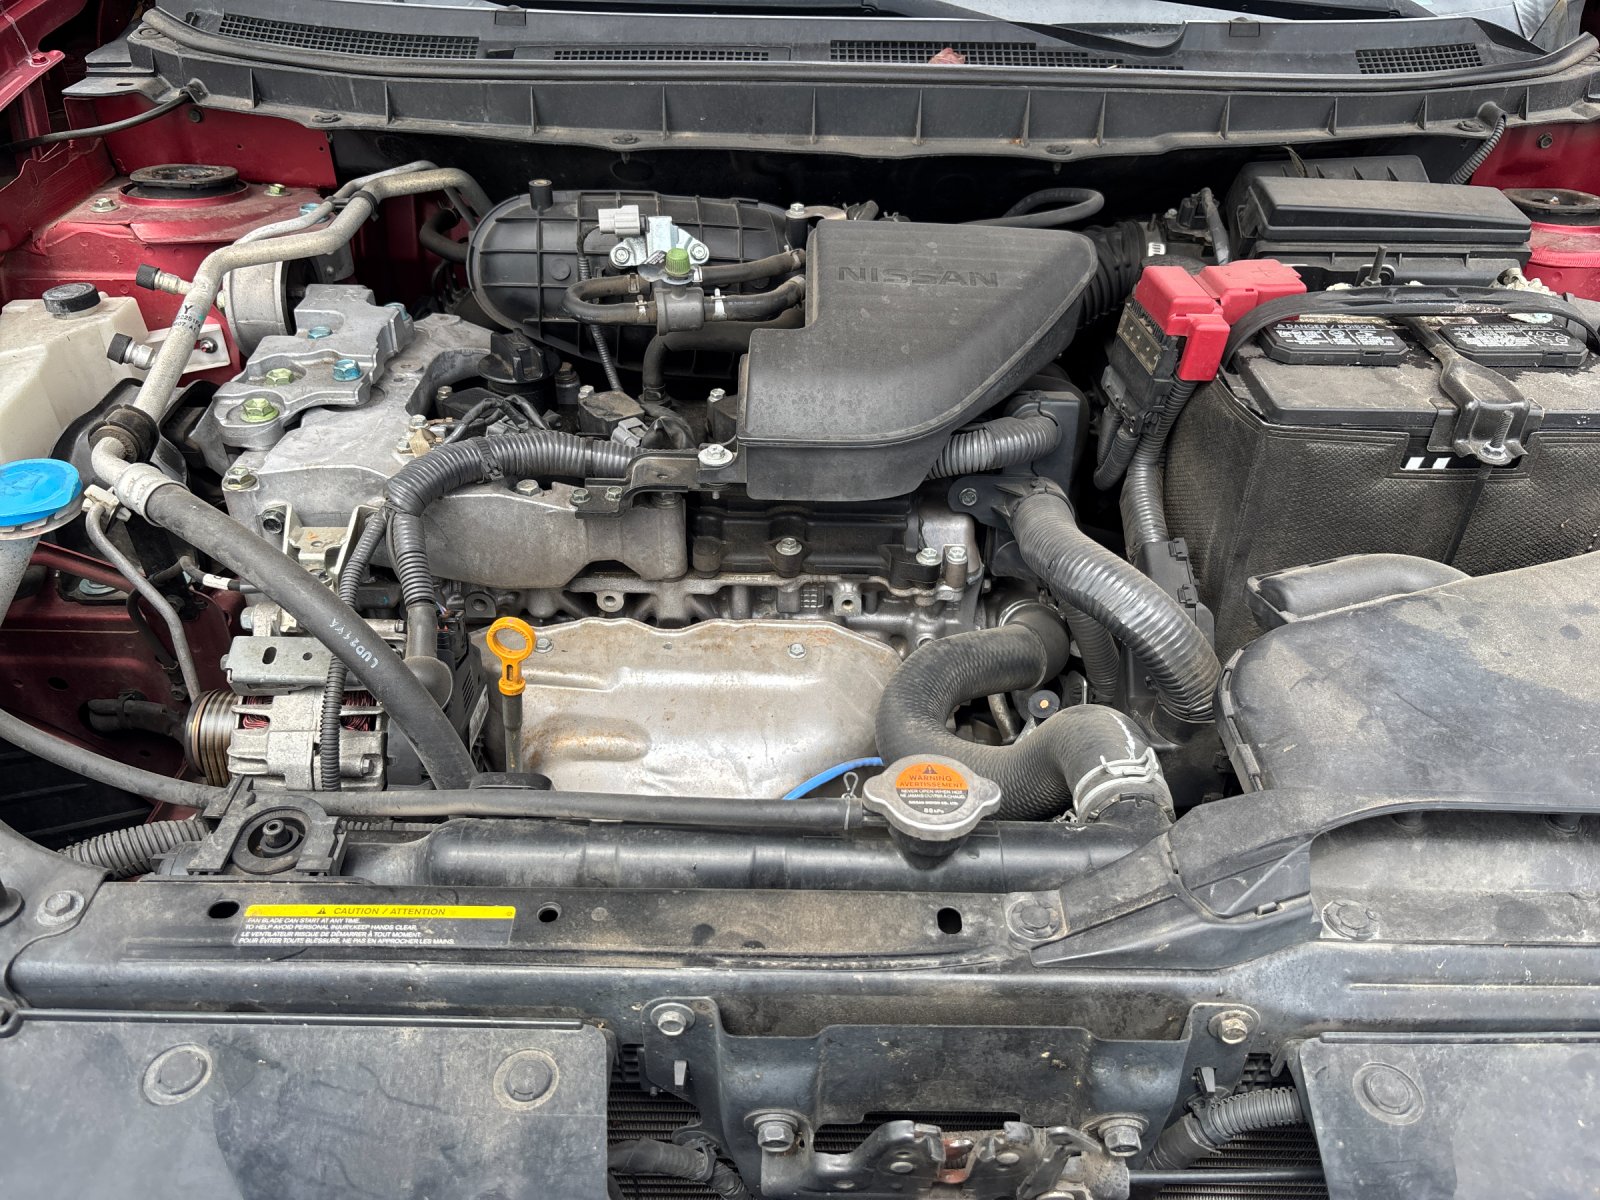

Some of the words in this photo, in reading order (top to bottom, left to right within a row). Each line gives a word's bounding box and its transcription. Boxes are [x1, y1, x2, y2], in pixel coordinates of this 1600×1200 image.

[838, 266, 999, 288] NISSAN
[334, 907, 379, 915] CAUTION
[389, 907, 446, 915] ATTENTION
[259, 936, 282, 944] ÉVITER
